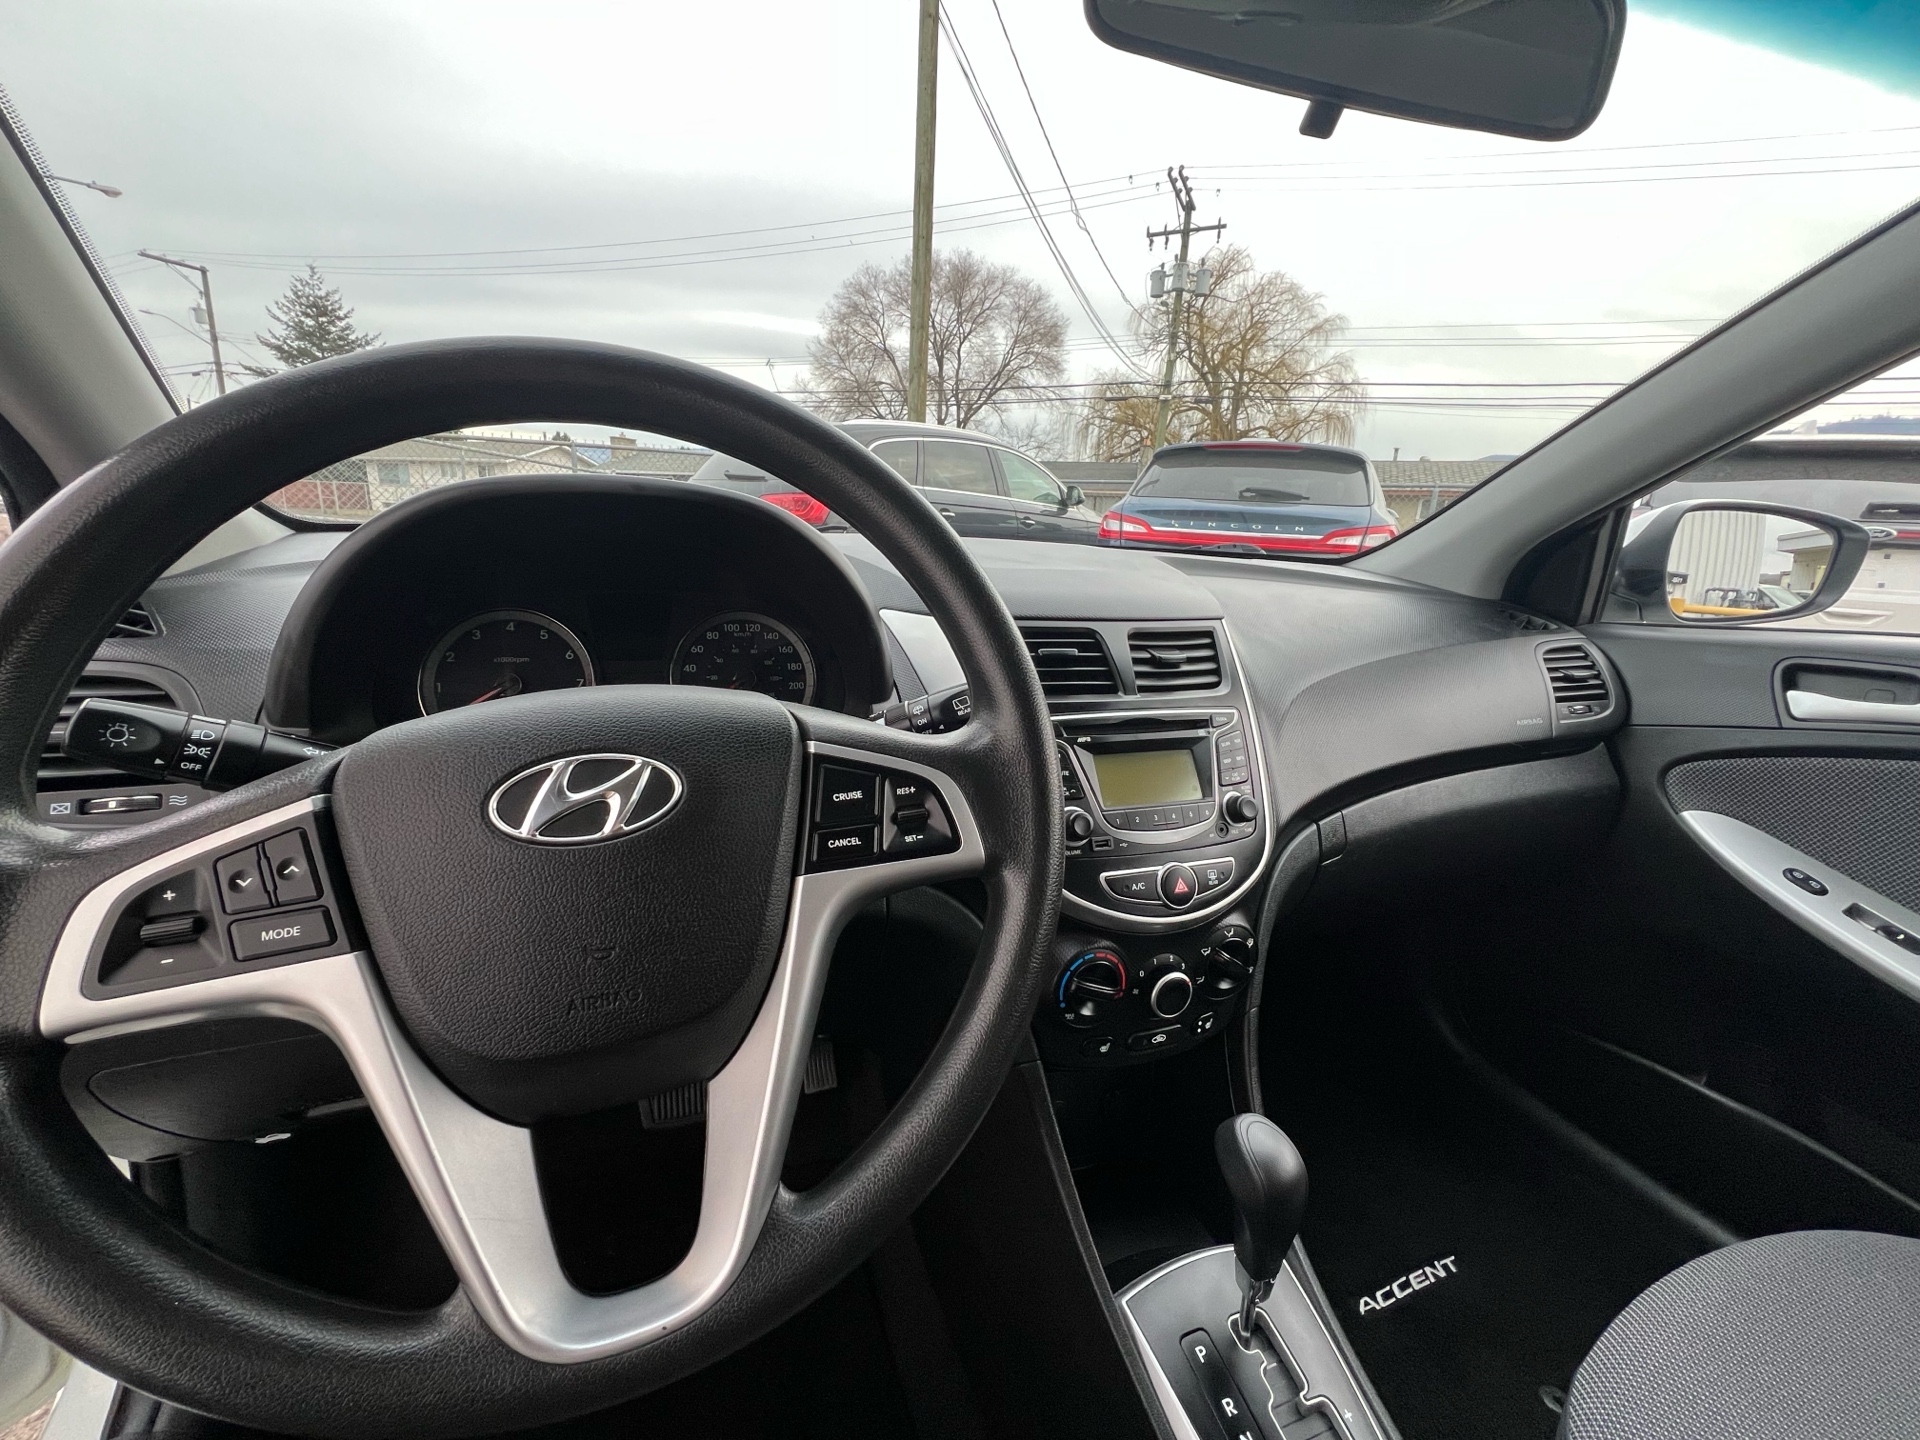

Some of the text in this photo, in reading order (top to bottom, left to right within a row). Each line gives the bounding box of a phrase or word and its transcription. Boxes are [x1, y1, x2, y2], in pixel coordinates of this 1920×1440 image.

[1171, 520, 1304, 531] LINCOLN
[506, 622, 515, 631] 4
[723, 623, 740, 632] 100
[745, 623, 761, 632] 120
[472, 629, 481, 640] 3
[540, 630, 549, 640] 5
[706, 631, 719, 640] 80
[763, 632, 779, 640] 140
[691, 645, 704, 653] 60
[446, 652, 455, 662] 2
[565, 650, 574, 659] 6
[683, 664, 697, 672] 40
[788, 682, 804, 690] 200
[180, 762, 203, 770] OFF
[896, 786, 916, 795] RES+
[833, 791, 863, 802] CRUISE
[828, 836, 861, 849] CANCEL
[1131, 882, 1146, 891] A/C
[261, 925, 301, 941] MODE
[1359, 1256, 1458, 1316] ACCENT
[1194, 1345, 1207, 1364] P
[1221, 1397, 1238, 1417] R
